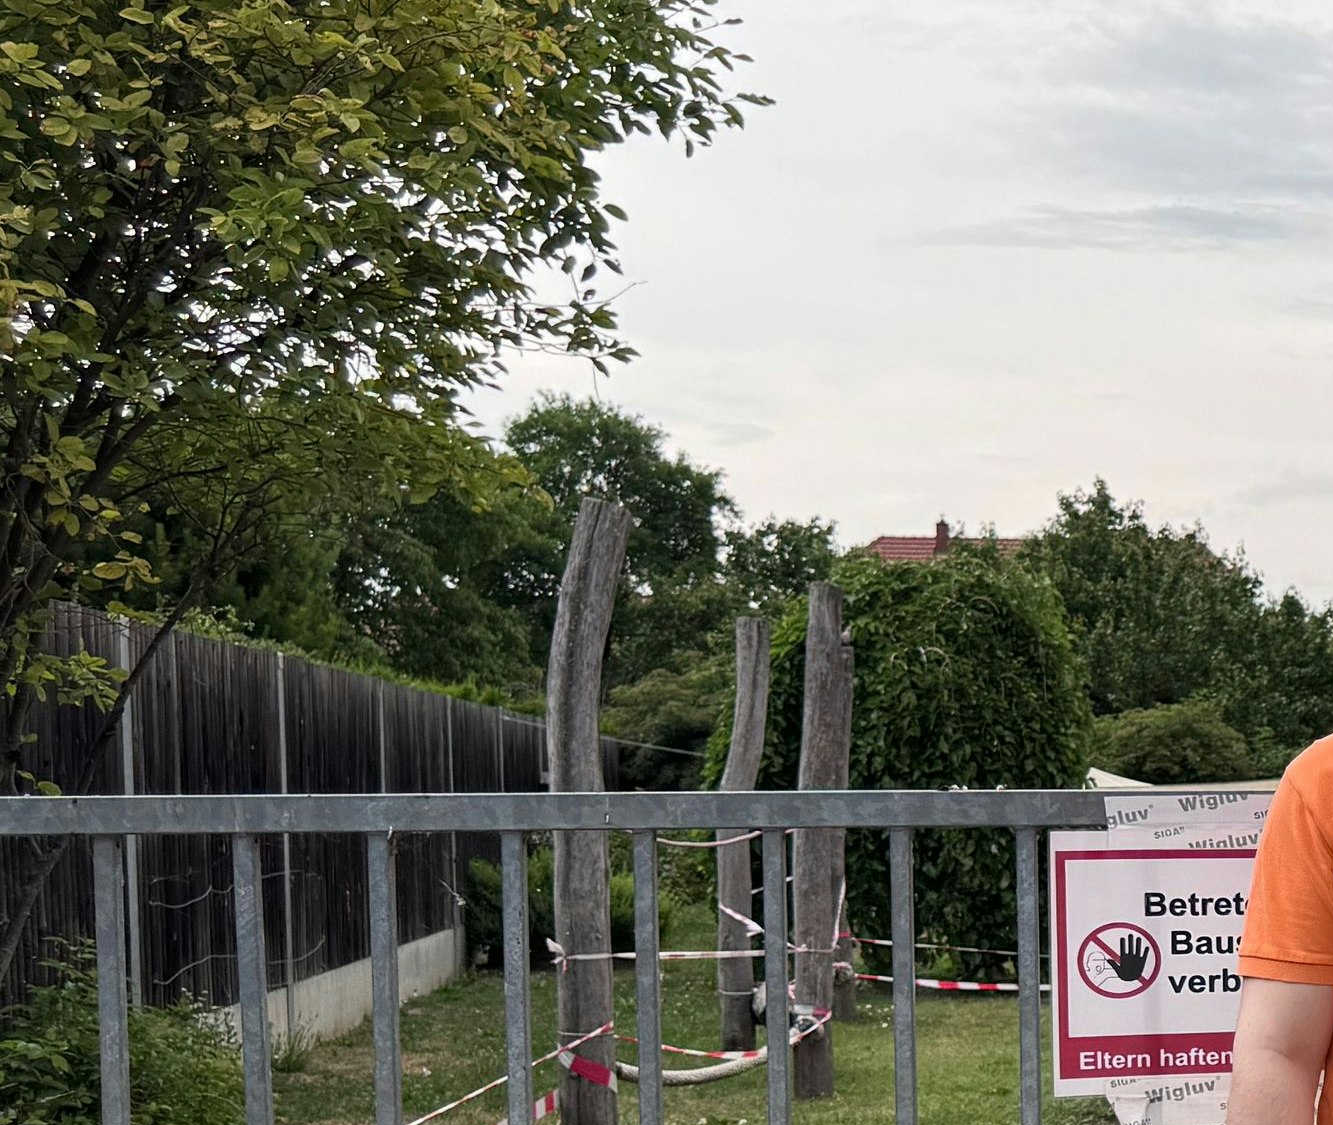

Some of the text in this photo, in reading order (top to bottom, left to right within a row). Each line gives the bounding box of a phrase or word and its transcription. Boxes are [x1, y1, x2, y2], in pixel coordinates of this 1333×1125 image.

[1144, 891, 1249, 917] Betret
[1168, 968, 1241, 994] verb
[1079, 1047, 1234, 1071] Eltern haften
[1144, 1080, 1216, 1104] Wigluv
